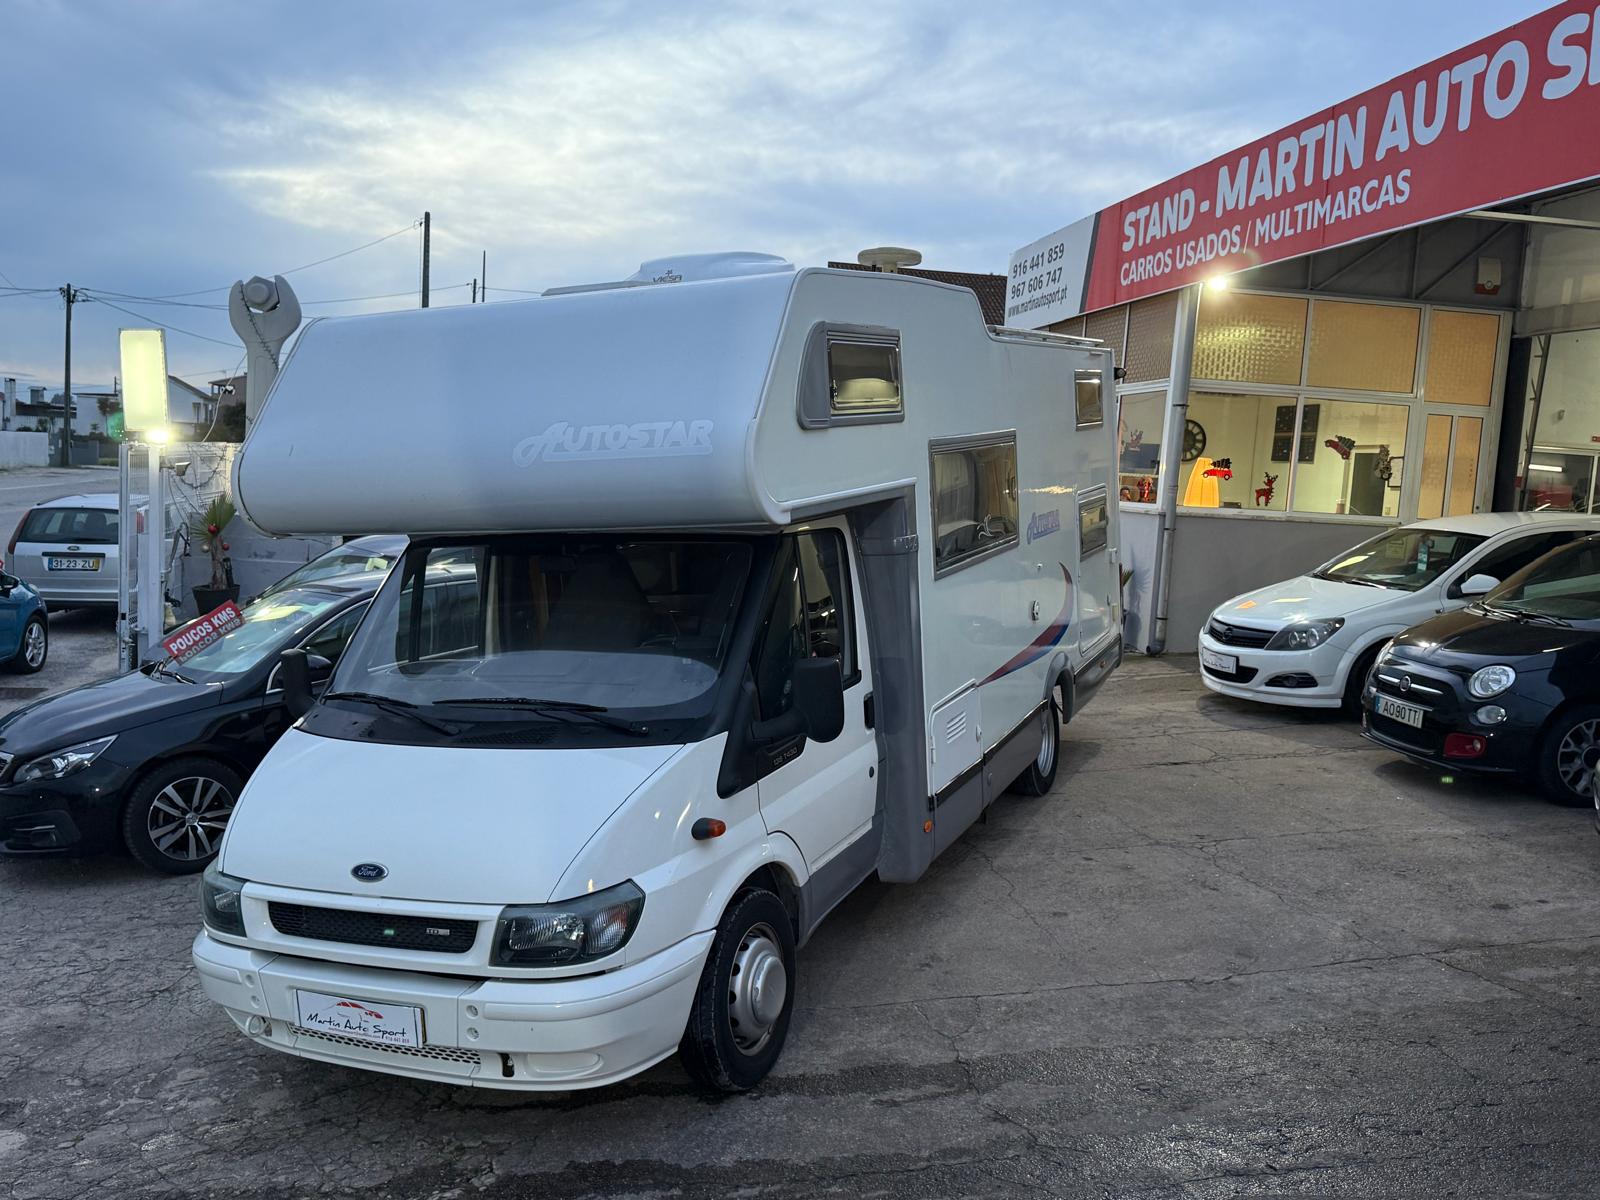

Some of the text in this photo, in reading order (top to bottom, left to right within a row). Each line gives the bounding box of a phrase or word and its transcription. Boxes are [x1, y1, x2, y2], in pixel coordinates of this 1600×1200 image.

[1122, 188, 1195, 252] STAND
[1215, 105, 1367, 218] MARTIN
[1375, 40, 1530, 162] AUTO
[1120, 248, 1172, 286] CARROS
[1176, 224, 1241, 270] USADOS
[1254, 168, 1411, 247] MULTIMARCAS
[1012, 243, 1065, 279] 916 441 859
[1011, 267, 1063, 300] 967 606 747
[512, 419, 714, 468] AUTOSTAR
[169, 621, 213, 655] POUCOS
[211, 607, 236, 628] KMS
[358, 866, 378, 877] Ford
[307, 1012, 340, 1027] Martin
[344, 1019, 369, 1033] Auto
[373, 1024, 406, 1039] Sport
